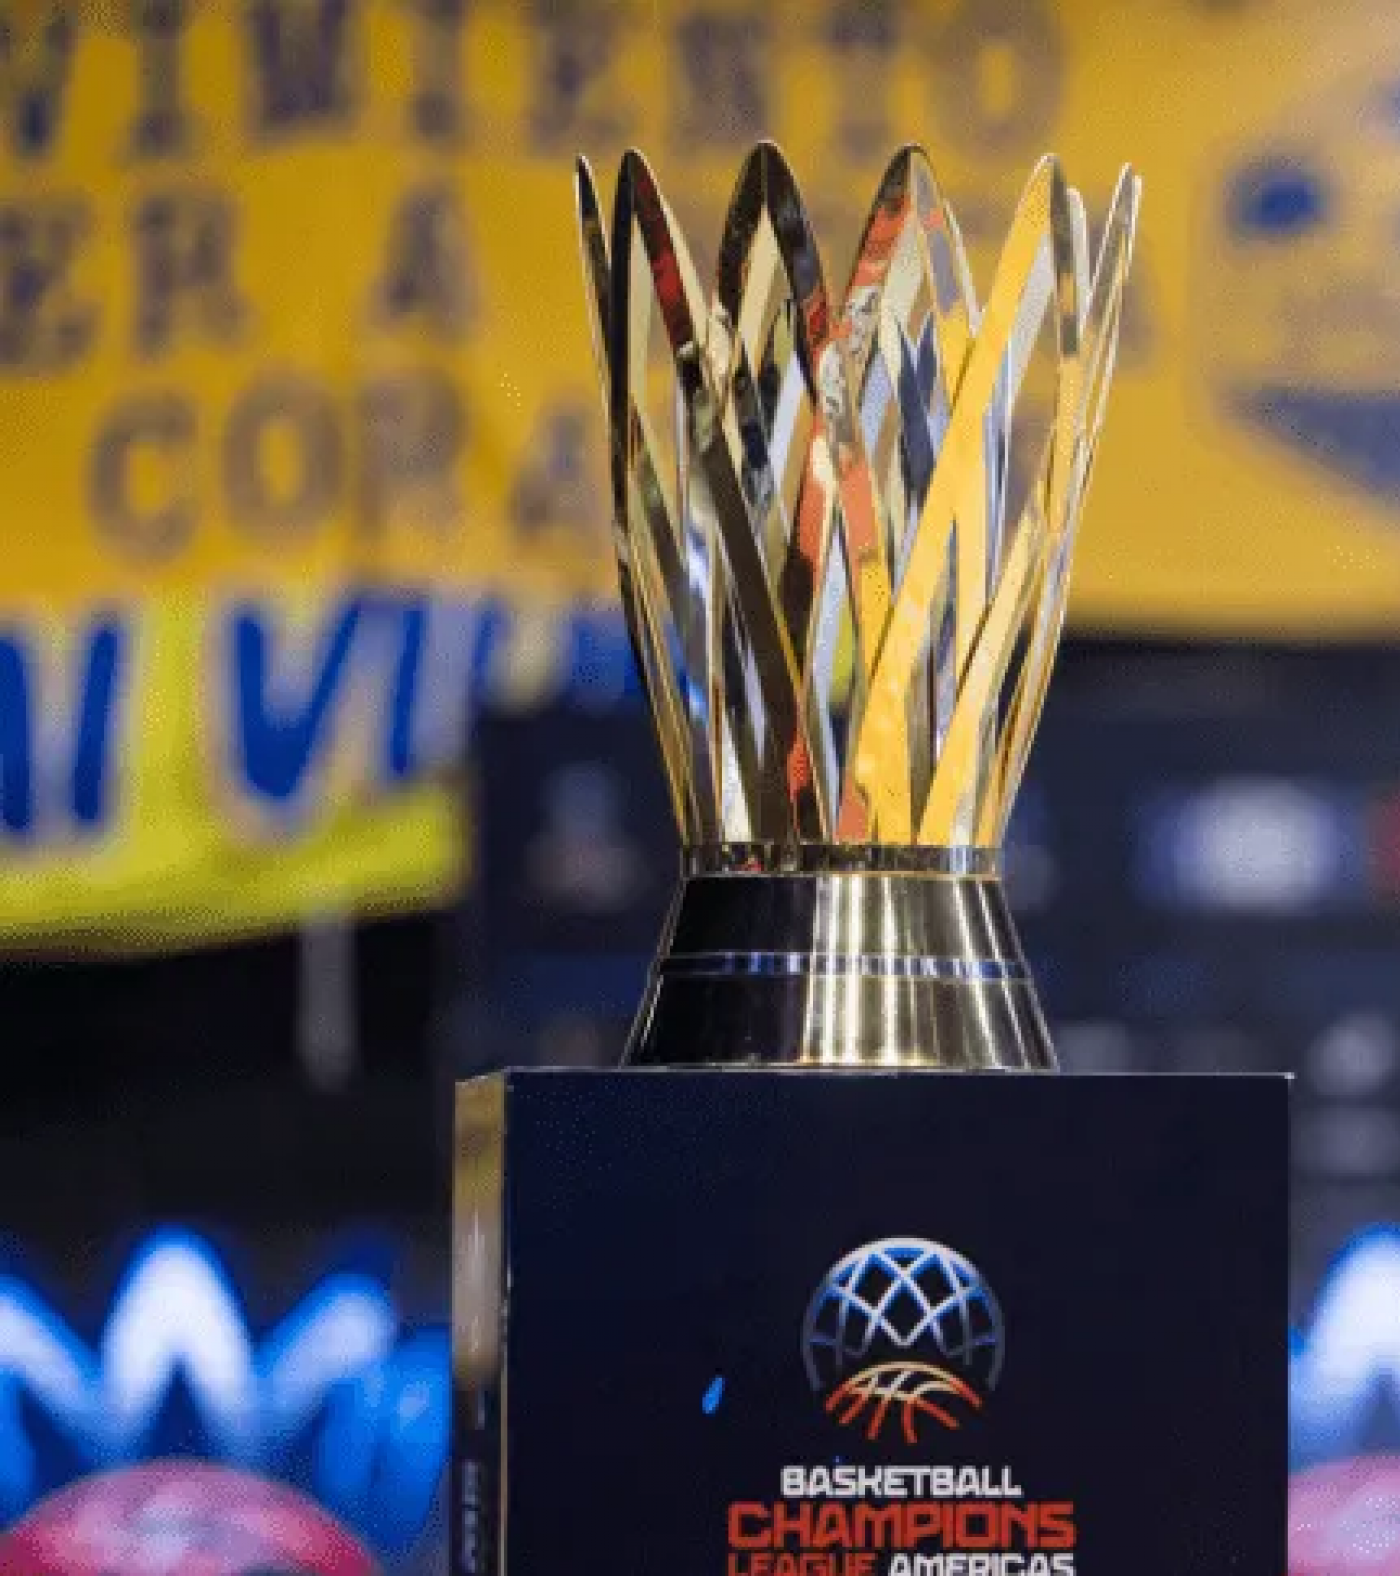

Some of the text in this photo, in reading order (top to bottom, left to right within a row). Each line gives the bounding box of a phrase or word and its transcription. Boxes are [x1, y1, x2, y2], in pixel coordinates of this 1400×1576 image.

[781, 1465, 1023, 1497] BASKETBALL
[727, 1500, 1077, 1549] CHAMPIONS
[727, 1552, 1077, 1576] LEAGUE AMERICAS
